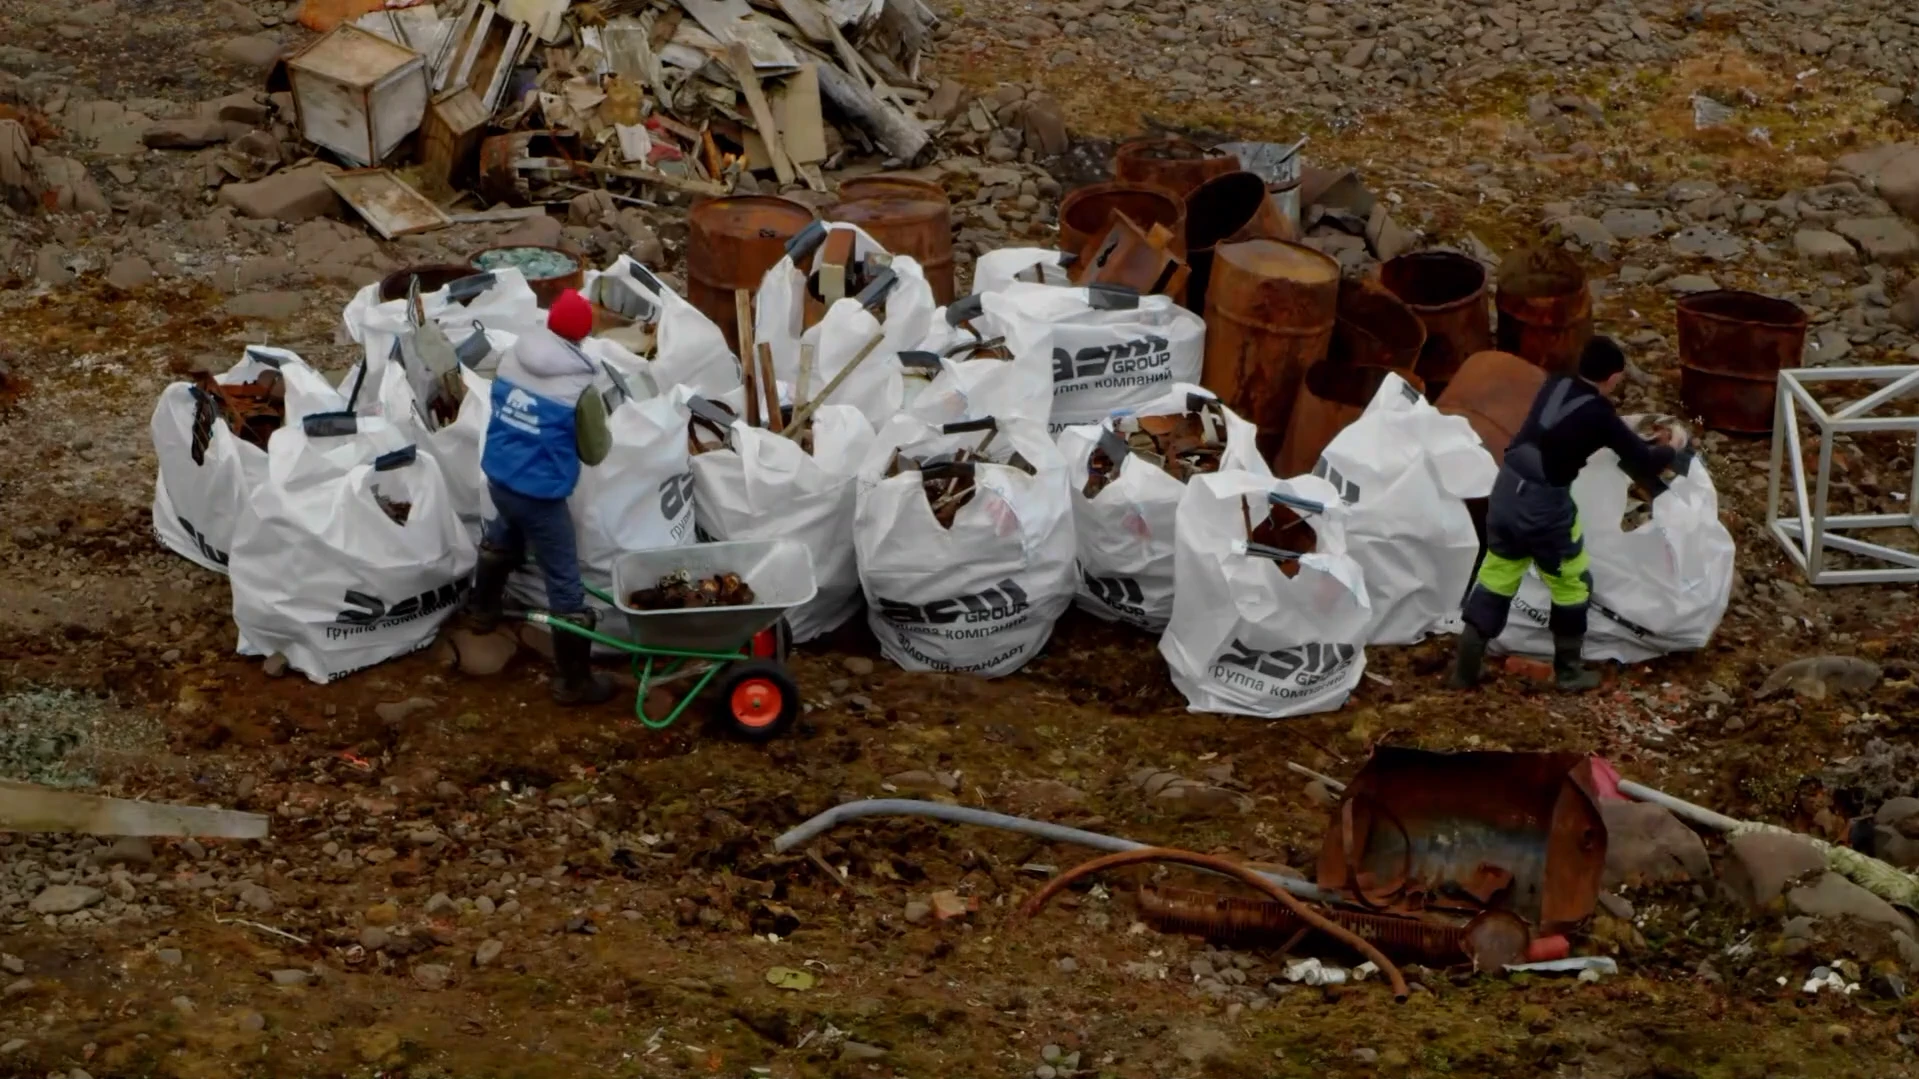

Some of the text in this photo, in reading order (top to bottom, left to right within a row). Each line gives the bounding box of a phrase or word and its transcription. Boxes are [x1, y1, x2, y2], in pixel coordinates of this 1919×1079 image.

[1112, 352, 1171, 374] GROUP
[1053, 368, 1173, 396] уппа компаний
[965, 602, 1030, 623] GROUP
